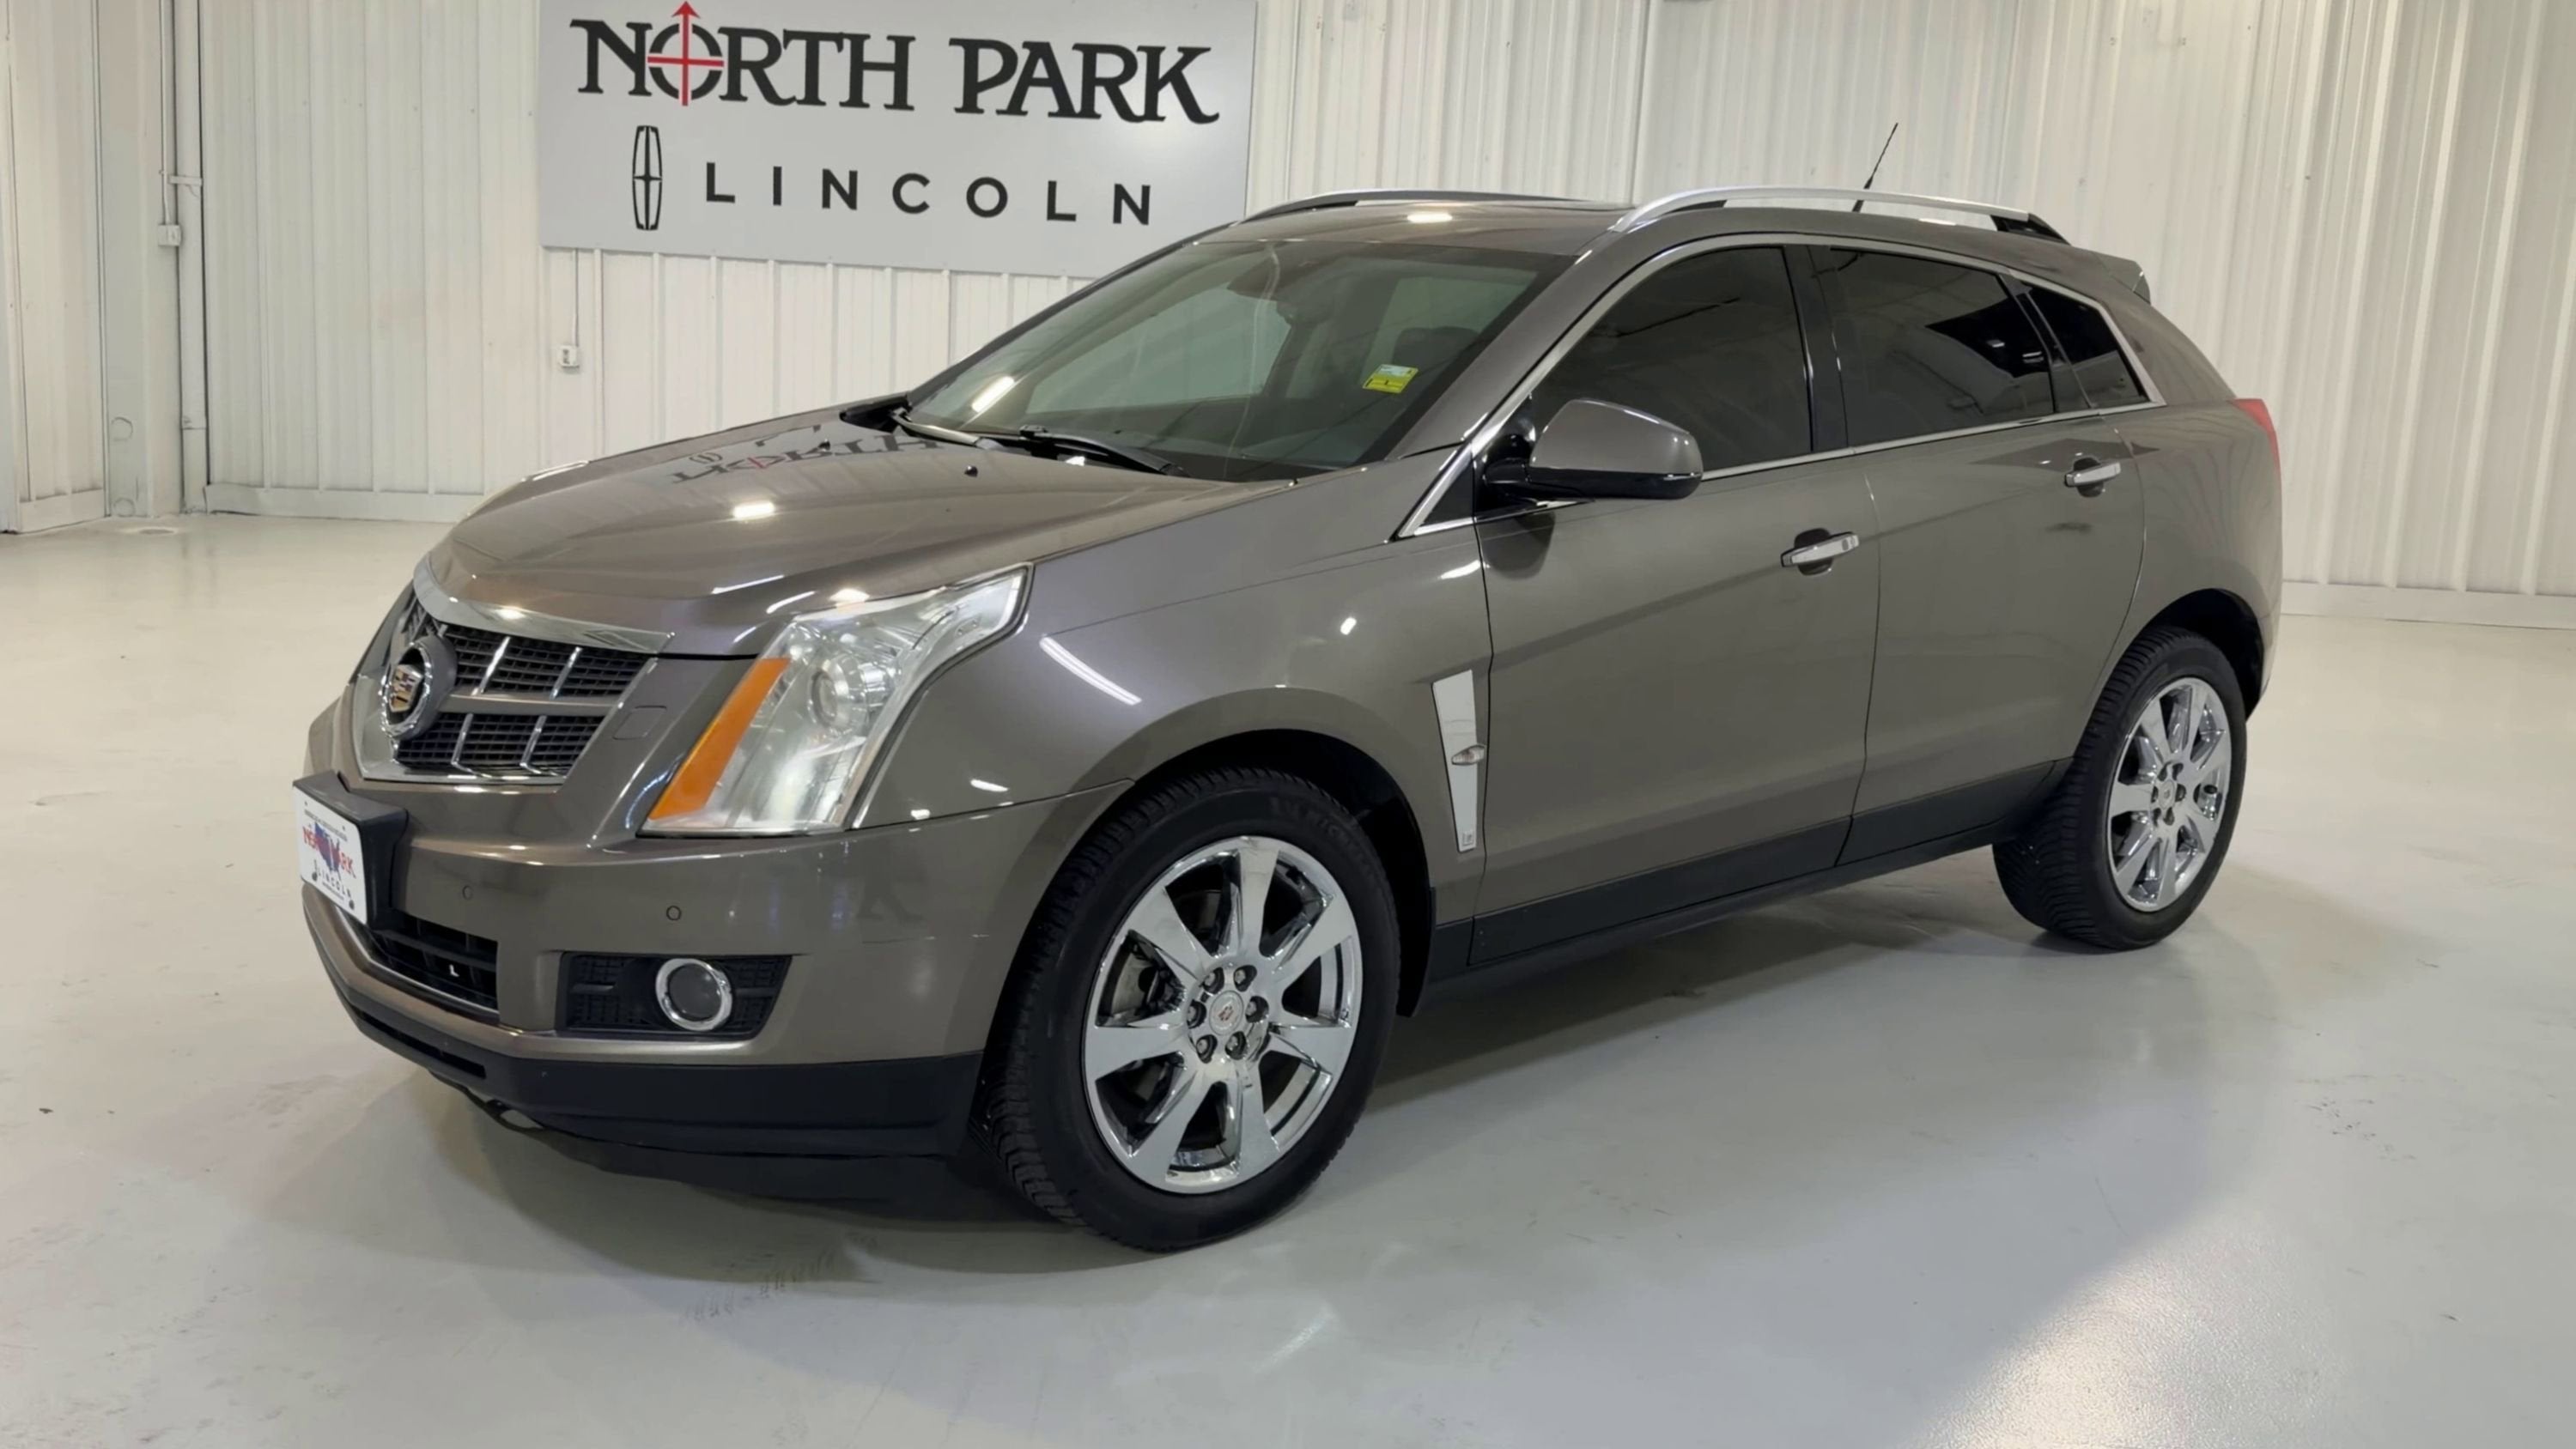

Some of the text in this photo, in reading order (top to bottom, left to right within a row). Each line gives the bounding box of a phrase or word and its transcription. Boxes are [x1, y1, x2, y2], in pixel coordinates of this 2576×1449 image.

[569, 19, 1220, 125] NORTH PARK
[705, 161, 1151, 227] LINCOLN
